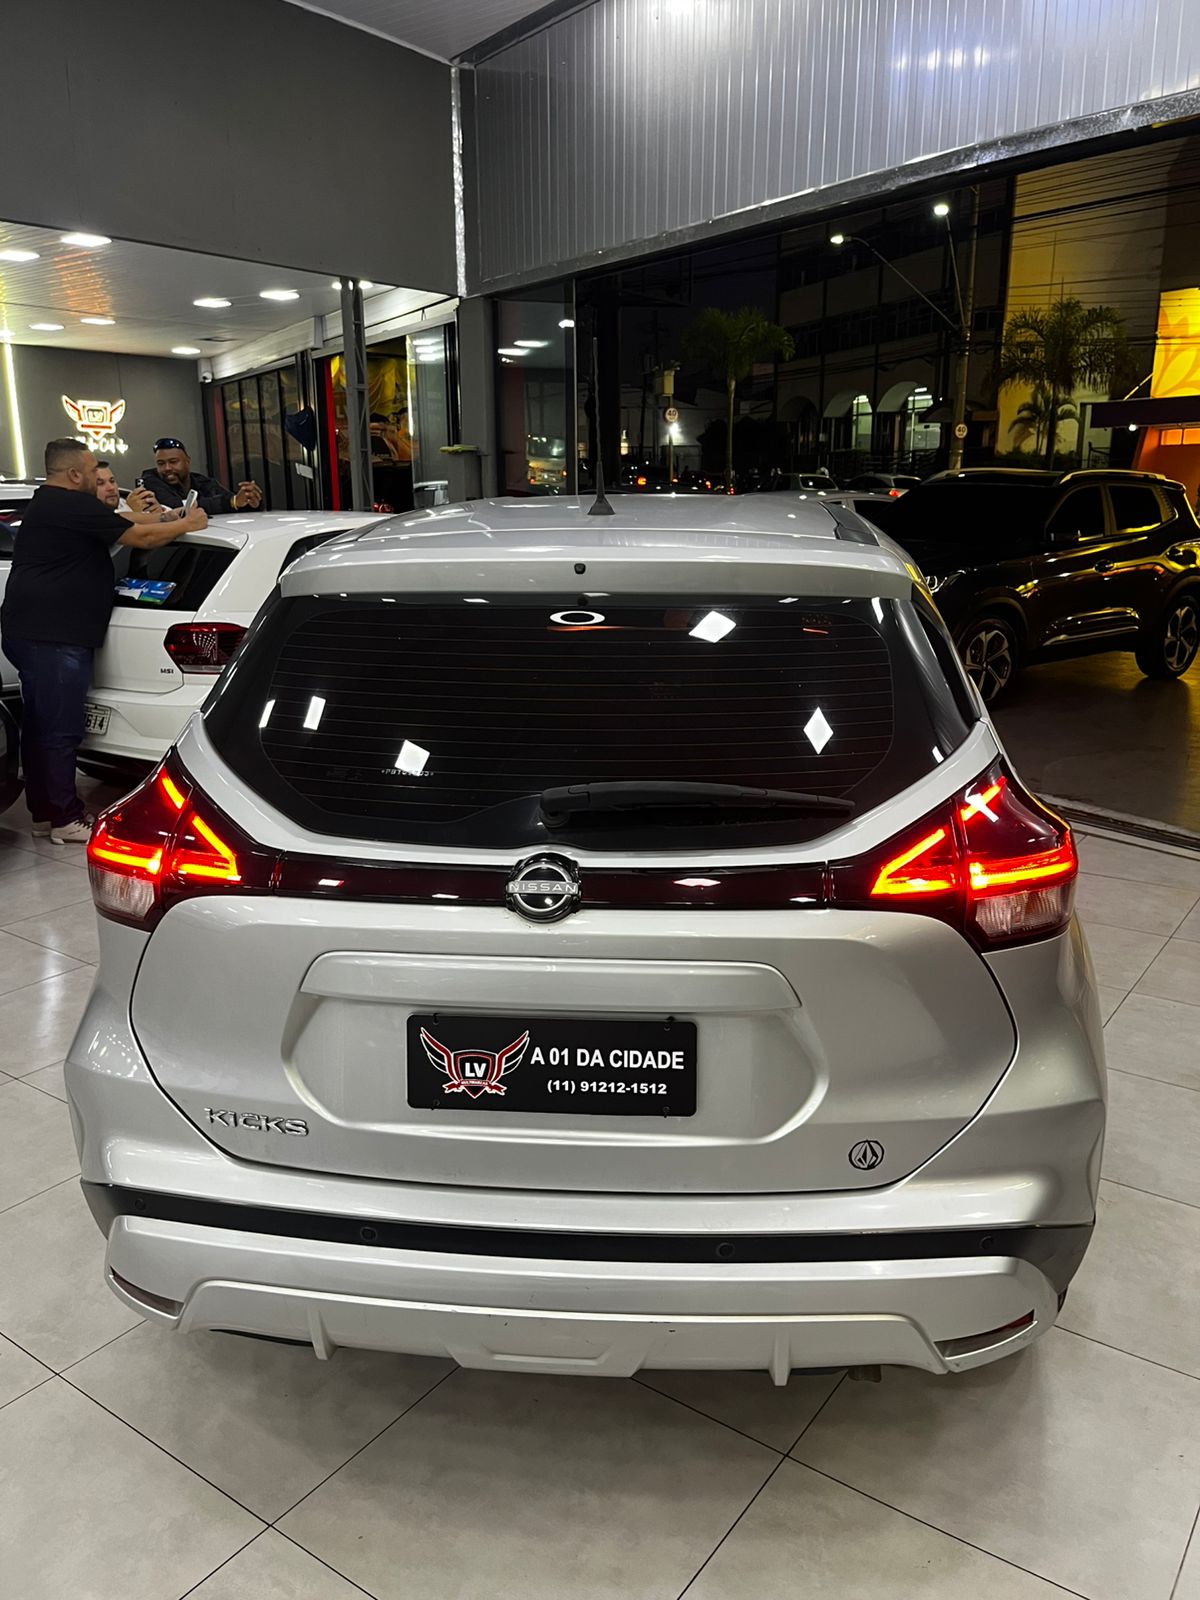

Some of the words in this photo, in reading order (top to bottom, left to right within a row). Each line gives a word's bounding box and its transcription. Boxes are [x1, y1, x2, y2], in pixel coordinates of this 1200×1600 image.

[509, 882, 577, 893] NISSAN
[531, 1047, 545, 1064] A
[550, 1048, 568, 1065] 01
[577, 1049, 604, 1067] DA
[610, 1050, 684, 1069] CIDADE
[465, 1063, 486, 1078] LV
[548, 1080, 575, 1093] (11)
[581, 1081, 666, 1094] 91212-1512
[204, 1107, 309, 1136] KICKS
